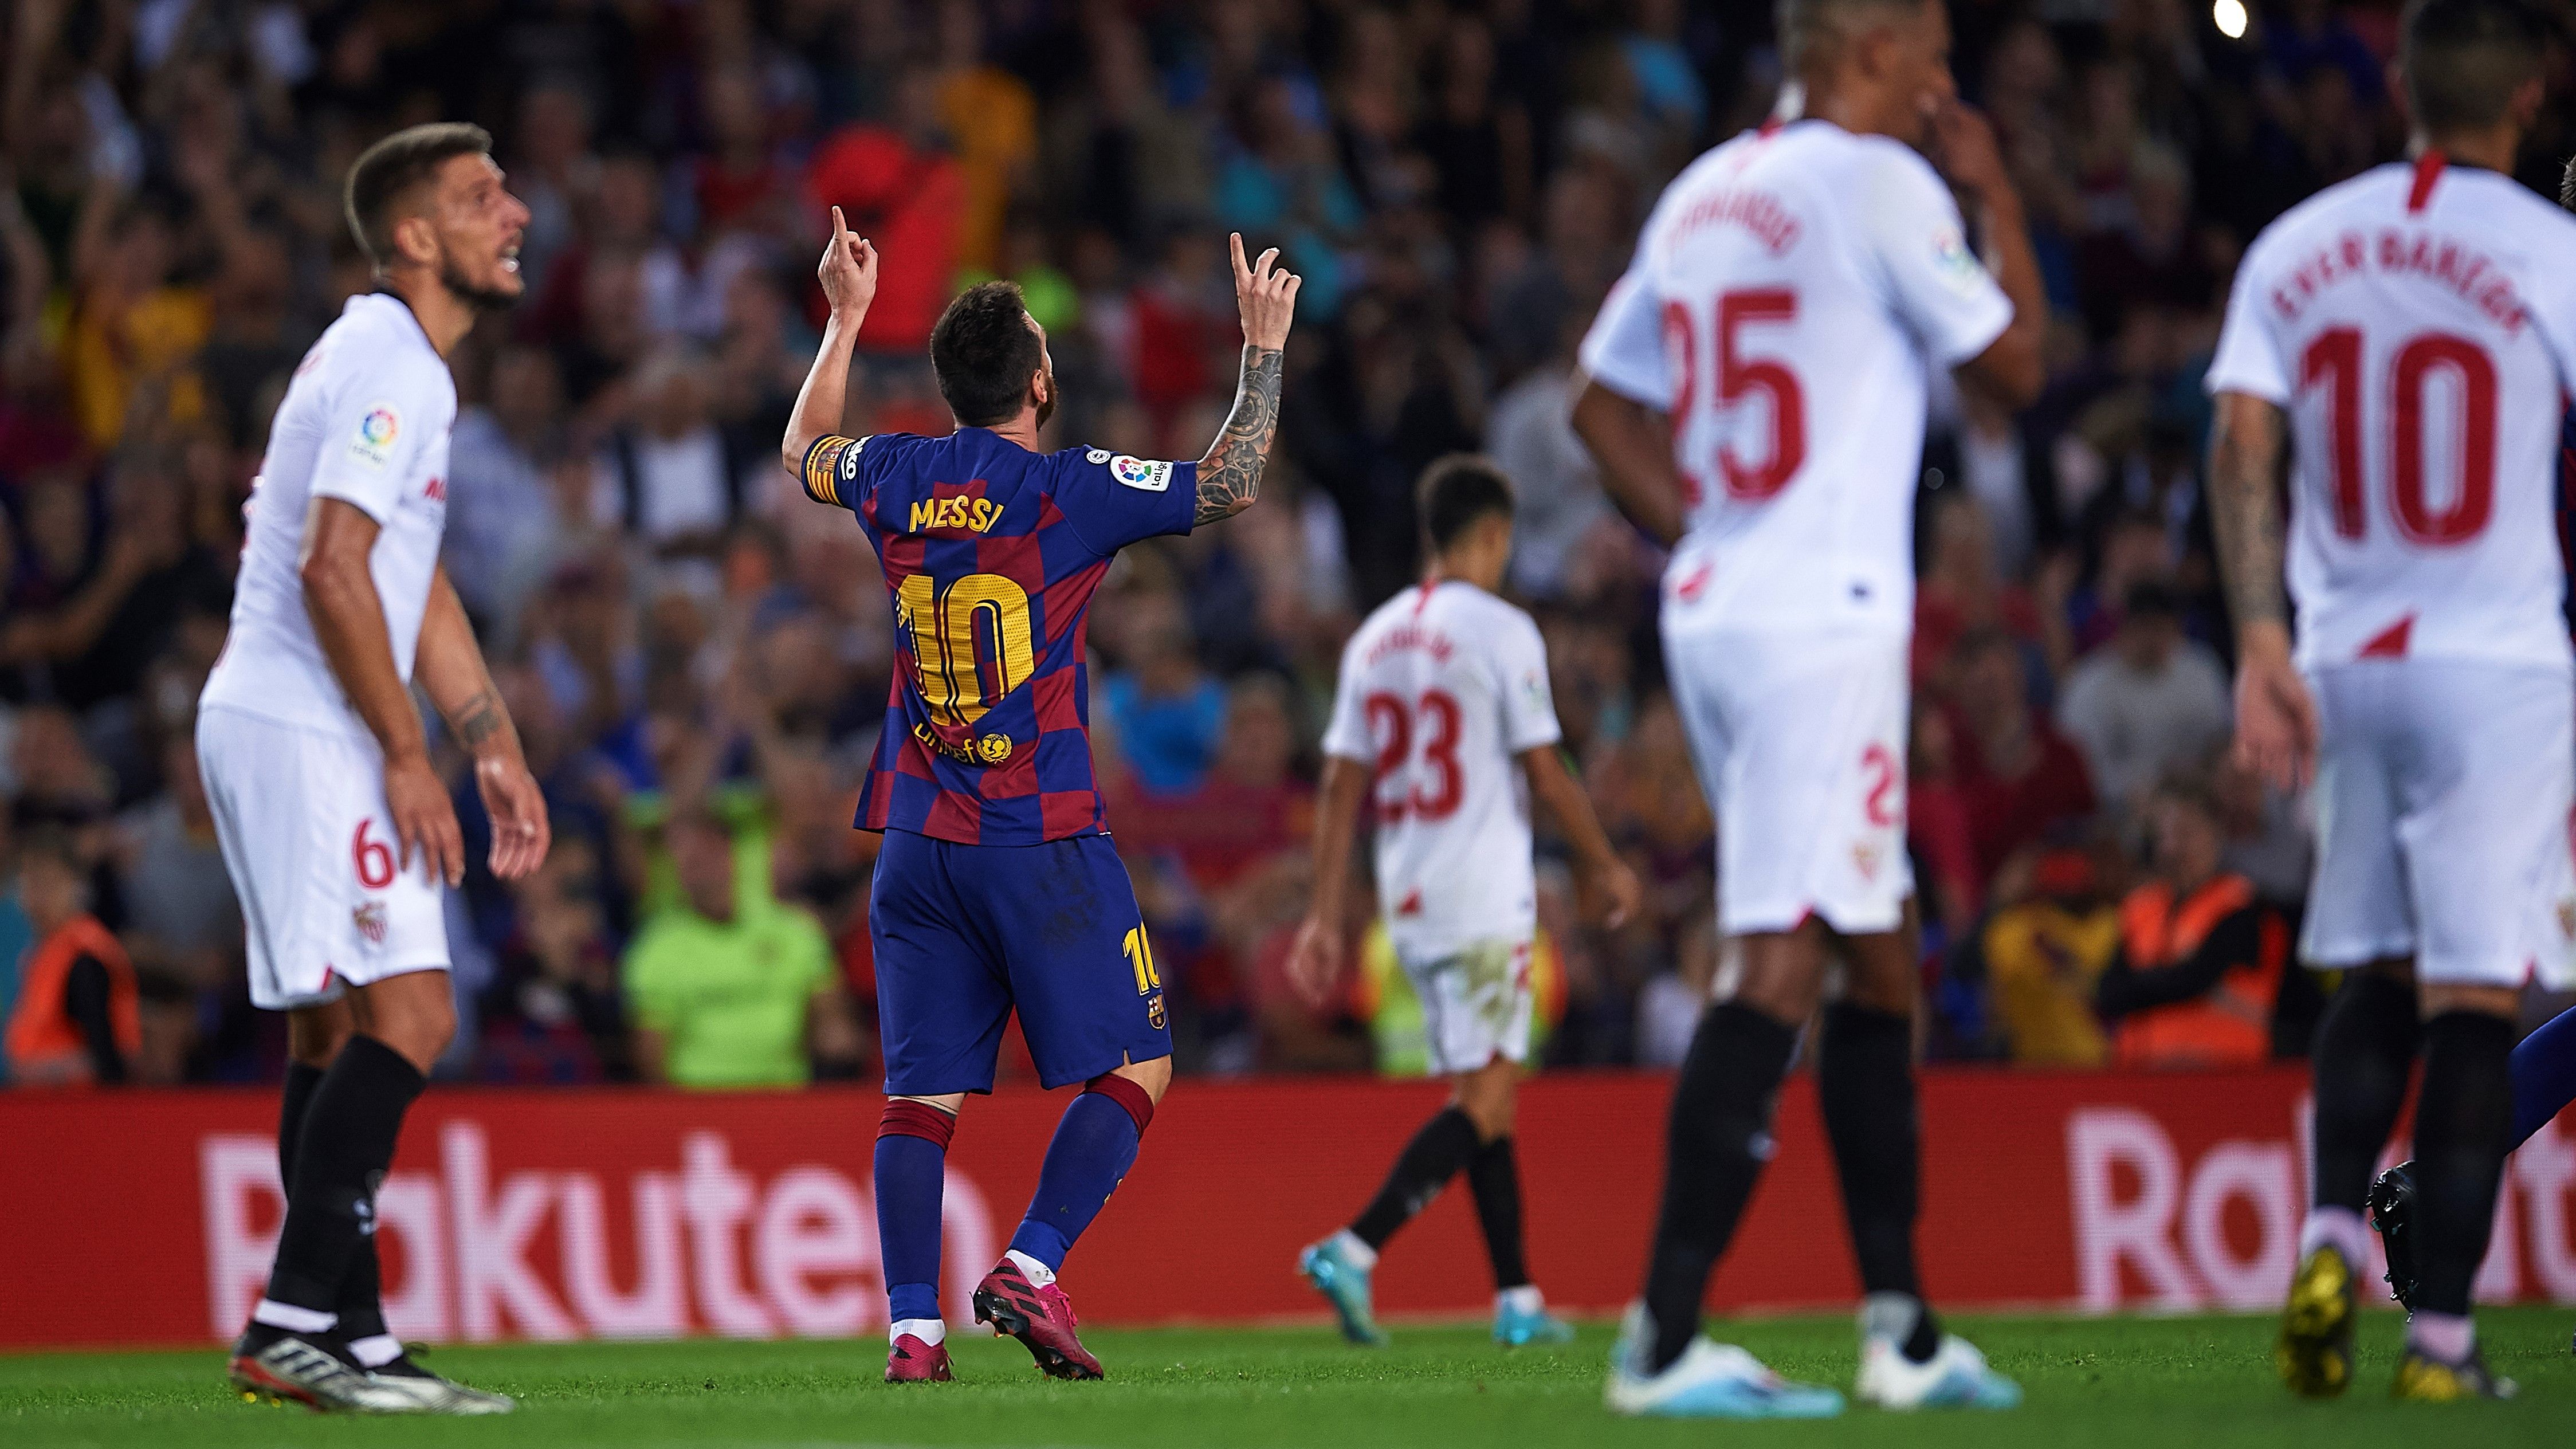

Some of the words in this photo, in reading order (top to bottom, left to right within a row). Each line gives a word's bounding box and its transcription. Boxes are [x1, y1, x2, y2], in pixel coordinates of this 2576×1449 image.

[2298, 324, 2500, 548] 10
[909, 494, 1004, 534] MESSI
[896, 574, 1036, 728] 10
[1365, 689, 1464, 824] 23
[352, 816, 396, 889] 6
